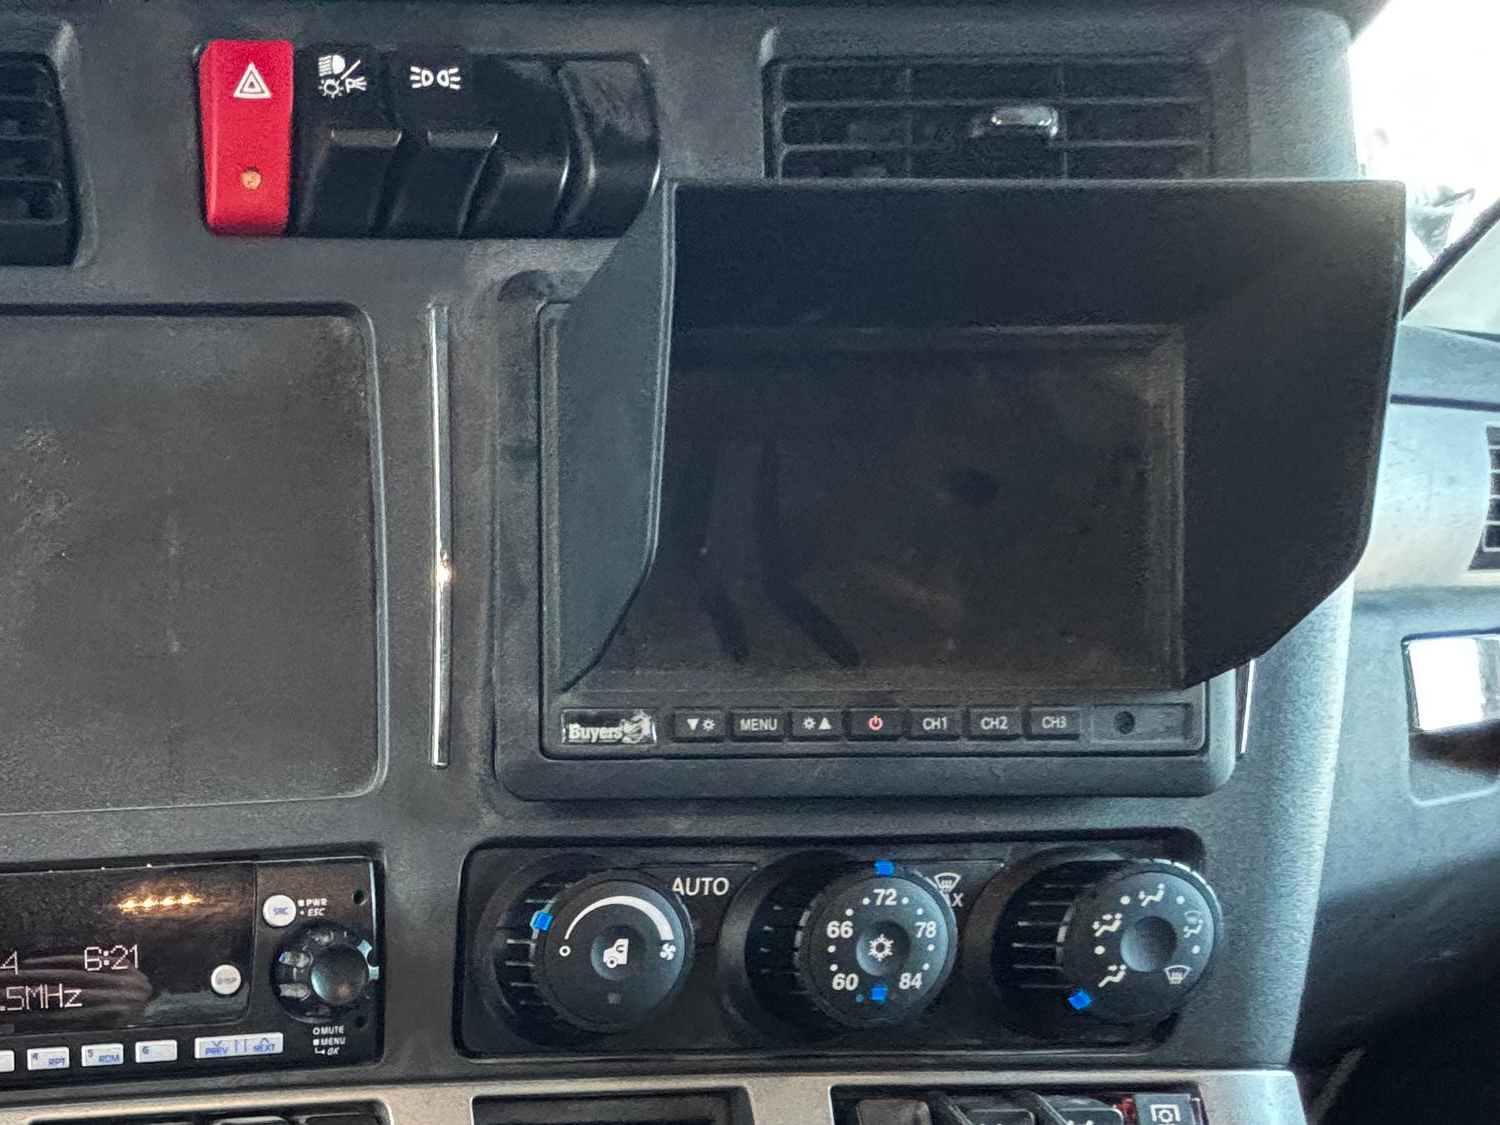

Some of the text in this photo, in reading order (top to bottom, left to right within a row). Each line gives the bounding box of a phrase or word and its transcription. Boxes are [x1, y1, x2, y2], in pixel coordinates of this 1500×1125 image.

[739, 717, 778, 731] MENU
[922, 716, 948, 731] CH1
[980, 716, 1009, 731] CH2
[1041, 716, 1068, 730] CH3
[568, 723, 623, 743] Buyers
[672, 876, 731, 897] AUTO
[873, 888, 898, 906] 72
[307, 908, 326, 918] ESC
[826, 920, 854, 939] 66
[914, 920, 938, 939] 78
[84, 944, 139, 972] 6:21
[832, 972, 860, 991] 60
[899, 972, 923, 990] 84
[320, 1025, 345, 1035] MUTE
[253, 1043, 277, 1054] NEXT
[321, 1036, 346, 1046] MENU
[205, 1046, 229, 1057] PREV
[48, 1057, 66, 1068] RPT
